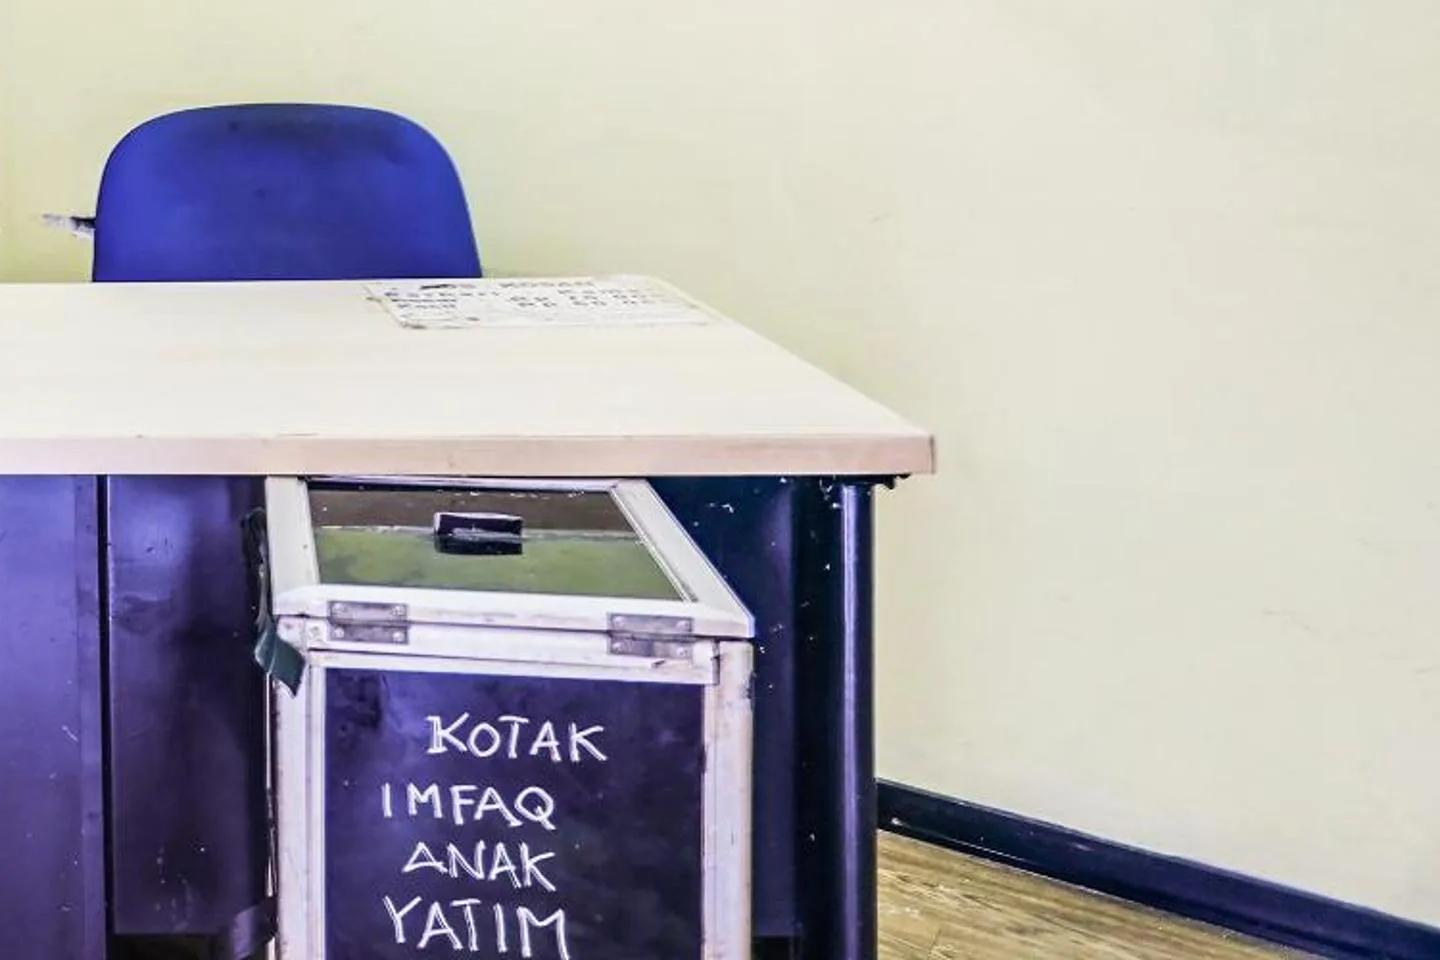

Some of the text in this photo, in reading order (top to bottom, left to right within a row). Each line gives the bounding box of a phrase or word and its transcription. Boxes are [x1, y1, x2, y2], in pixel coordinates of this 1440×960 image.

[426, 712, 607, 761] KOTAK
[381, 782, 556, 830] IMFAQ
[402, 841, 556, 892] ANAK
[382, 896, 570, 960] YATIM
